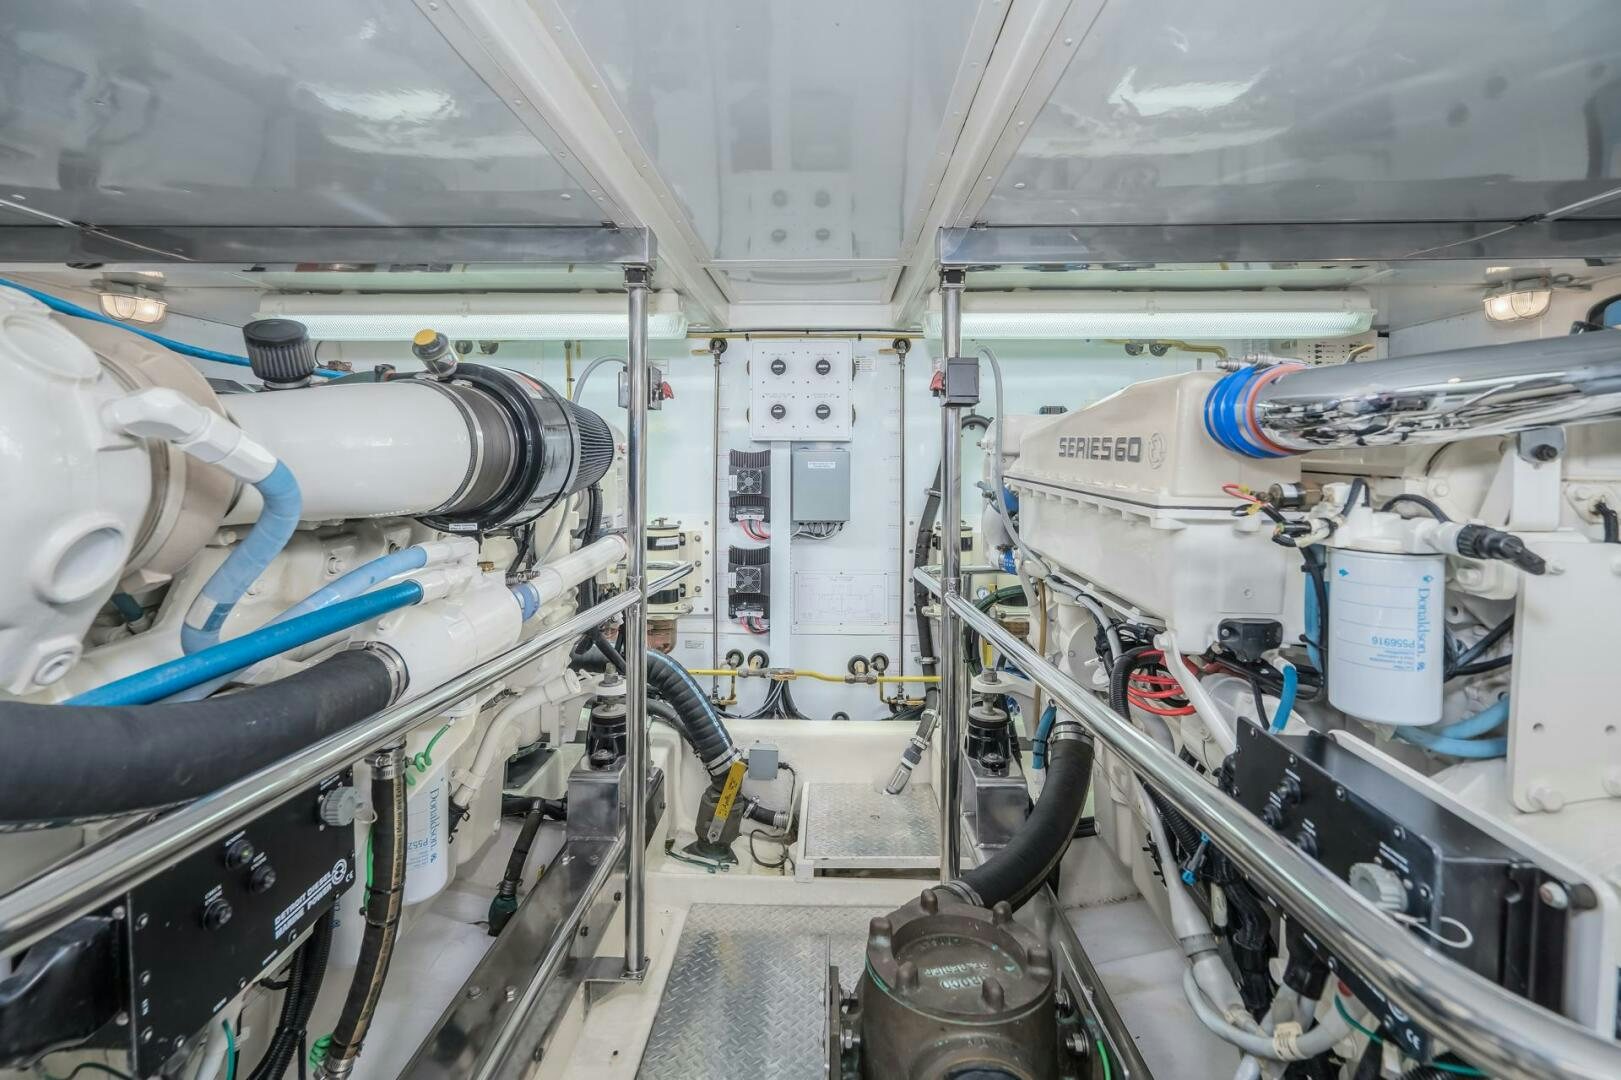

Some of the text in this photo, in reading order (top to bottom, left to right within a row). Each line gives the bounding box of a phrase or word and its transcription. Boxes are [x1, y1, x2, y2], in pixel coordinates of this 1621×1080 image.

[1058, 437, 1141, 463] SERIES 60
[1371, 636, 1416, 648] P556916
[274, 892, 307, 926] DETROIT
[307, 871, 332, 897] DIESEL
[275, 906, 305, 940] MARINE
[307, 882, 333, 911] POWER
